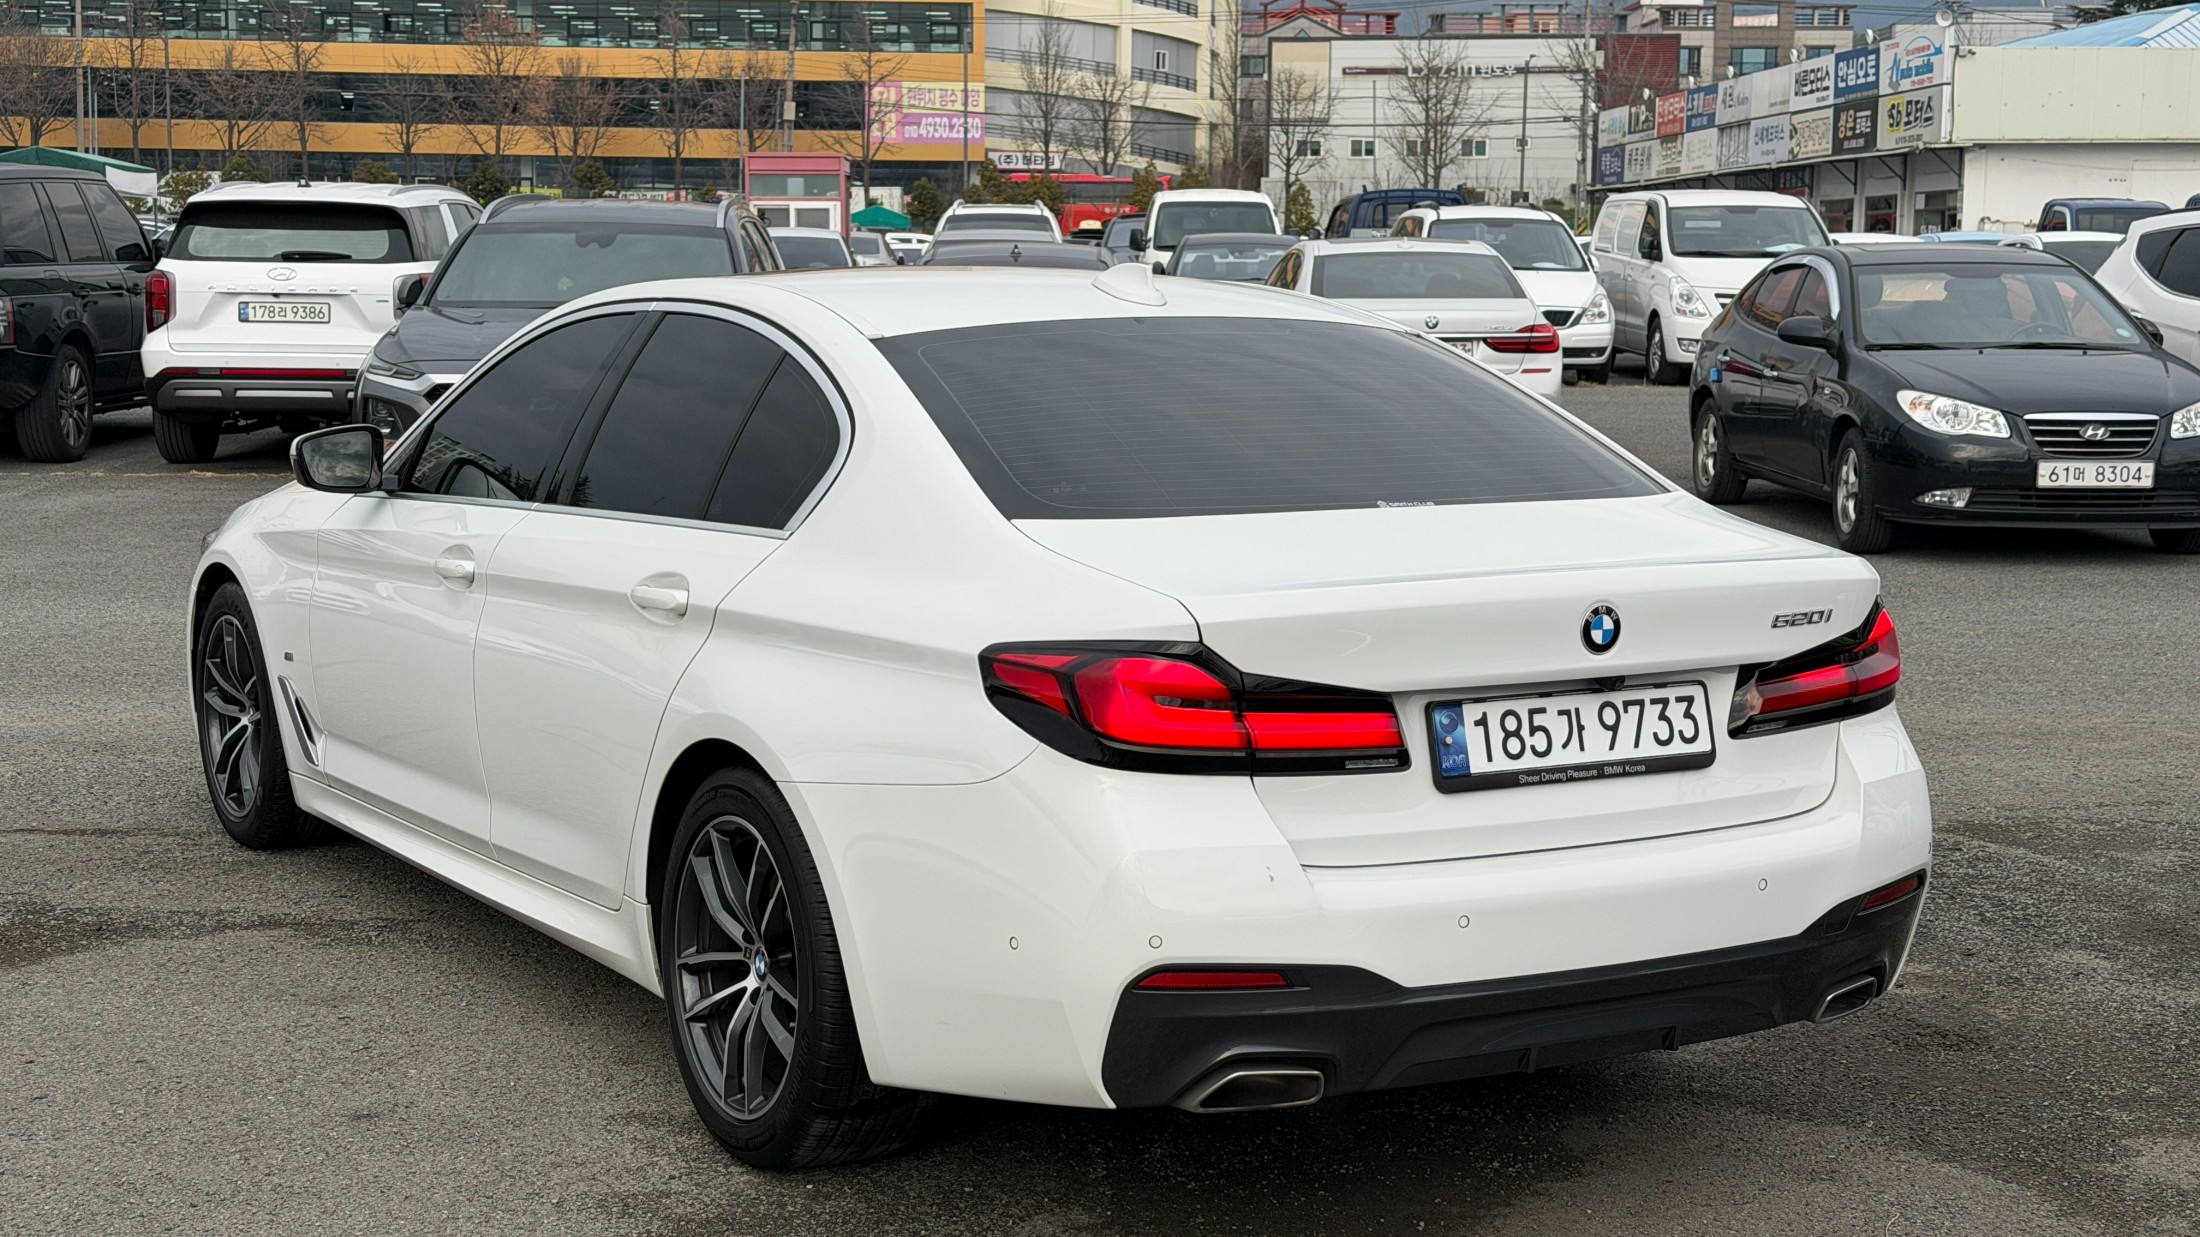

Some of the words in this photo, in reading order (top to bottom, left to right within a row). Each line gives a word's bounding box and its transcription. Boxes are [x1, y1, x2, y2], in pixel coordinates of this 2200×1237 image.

[1480, 63, 1517, 78] 윈도우
[1794, 64, 1831, 97] 바른모터스
[1837, 54, 1877, 89] 안심오토
[1903, 95, 1934, 130] 모터스
[904, 124, 918, 138] 010
[1838, 109, 1855, 138] 성은
[1854, 116, 1872, 135] 모터스
[997, 154, 1019, 166] (주)
[291, 306, 326, 320] 9386
[2048, 465, 2085, 483] 61머
[2094, 465, 2142, 483] 8304
[1770, 607, 1834, 629] 520i
[1473, 706, 1587, 763] 185가
[1597, 694, 1700, 751] 9733
[1442, 754, 1467, 769] KOR
[1518, 773, 1541, 784] Sheer
[1541, 769, 1567, 783] Driving
[1567, 768, 1598, 780] Pleasure
[1604, 765, 1624, 775] BMW
[1625, 764, 1646, 774] Korea
